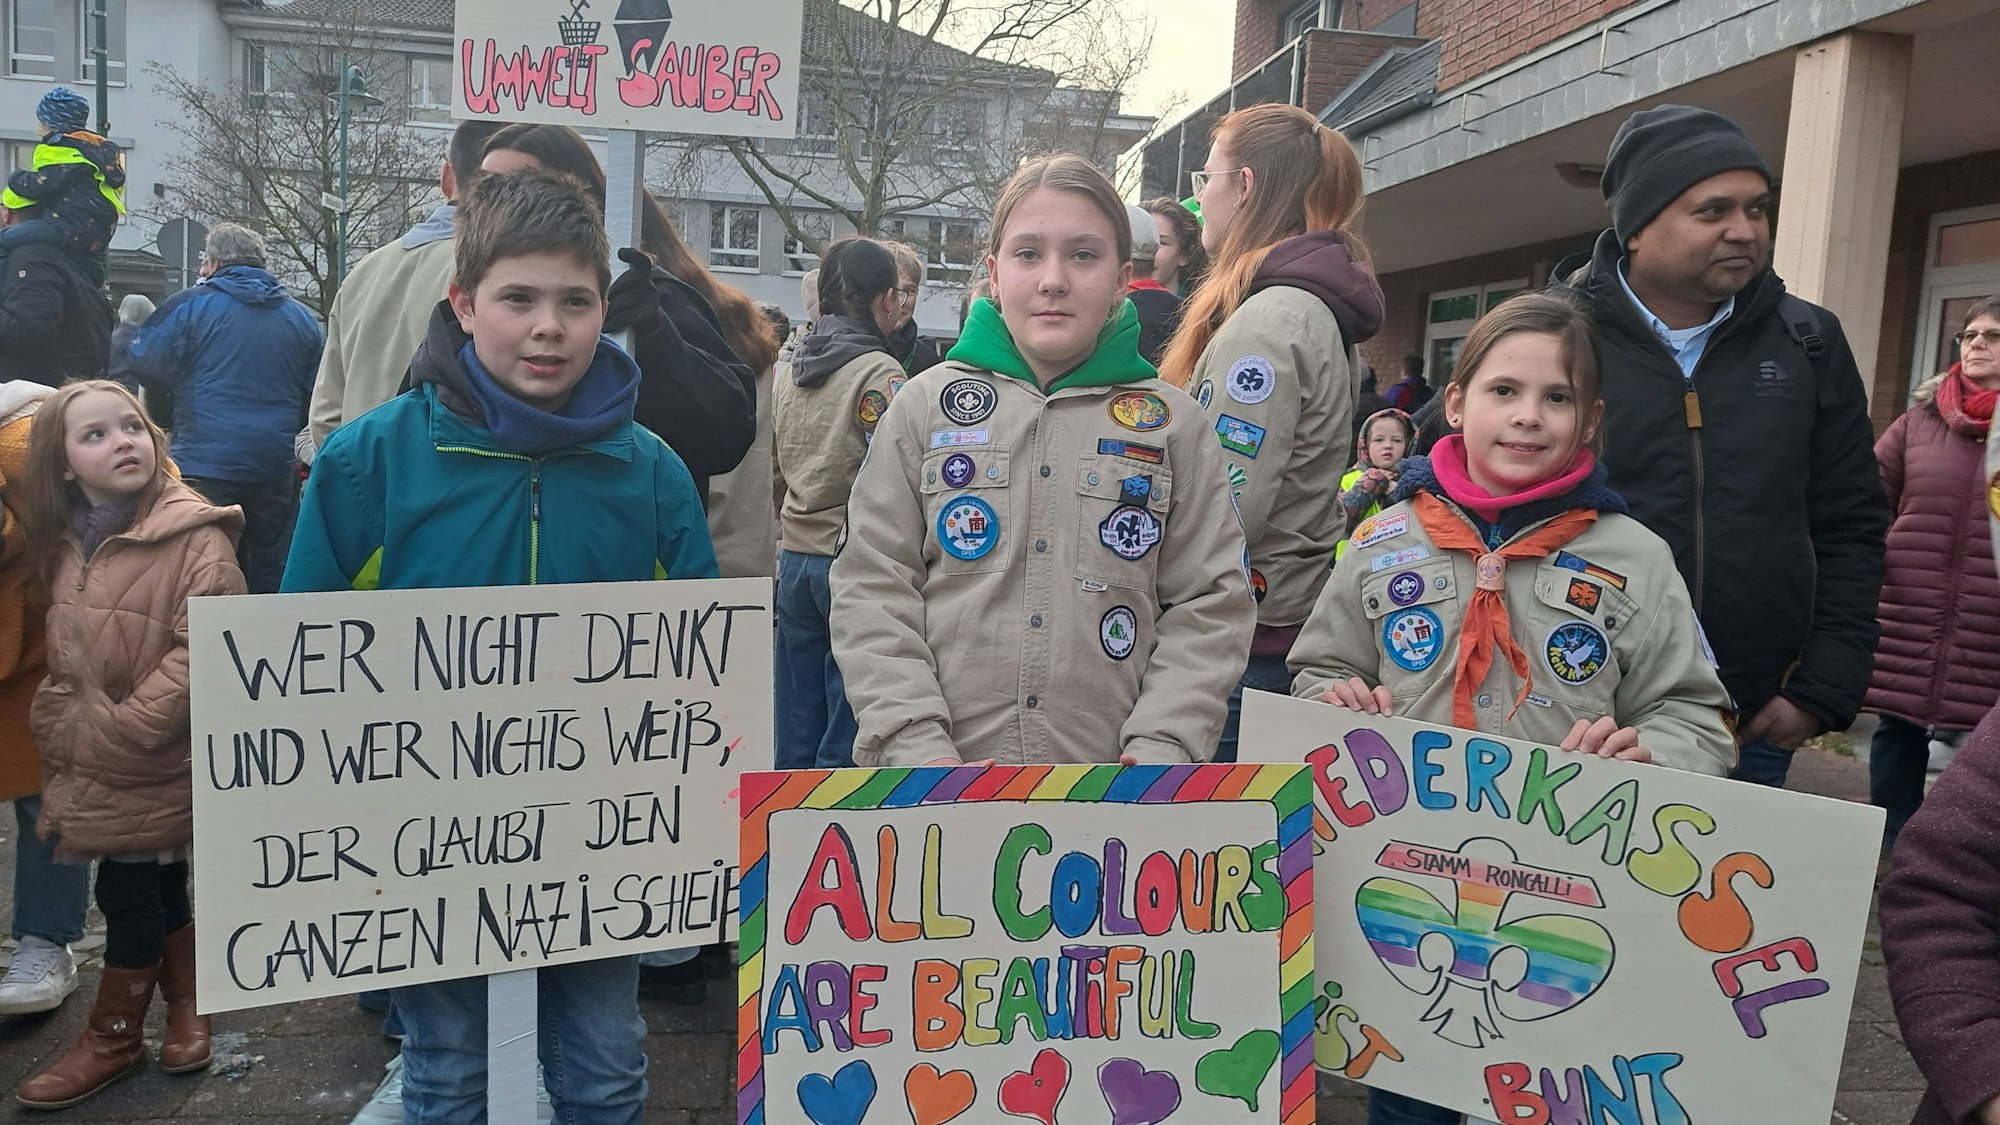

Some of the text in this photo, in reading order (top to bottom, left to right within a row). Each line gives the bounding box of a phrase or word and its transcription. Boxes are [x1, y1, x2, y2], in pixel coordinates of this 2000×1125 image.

[462, 38, 783, 121] UMWELT SAUBER
[950, 407, 986, 420] SINCE 1907
[951, 383, 990, 397] SCOUTING
[1377, 516, 1405, 528] SONNE
[223, 602, 765, 701] WER NICHT DENKT
[1549, 646, 1568, 676] Kein
[208, 727, 305, 790] UND
[322, 720, 440, 784] WER
[452, 708, 586, 780] NICHTS
[252, 785, 681, 889] DER GLAUBT DEN
[1403, 849, 1471, 878] STAMM
[784, 822, 1289, 945] ALL COLOURS
[1304, 728, 1830, 1039] EDERKASSEL
[226, 897, 446, 991] GANZEN
[763, 960, 892, 1053] ARE
[1484, 1052, 1692, 1125] BUNT
